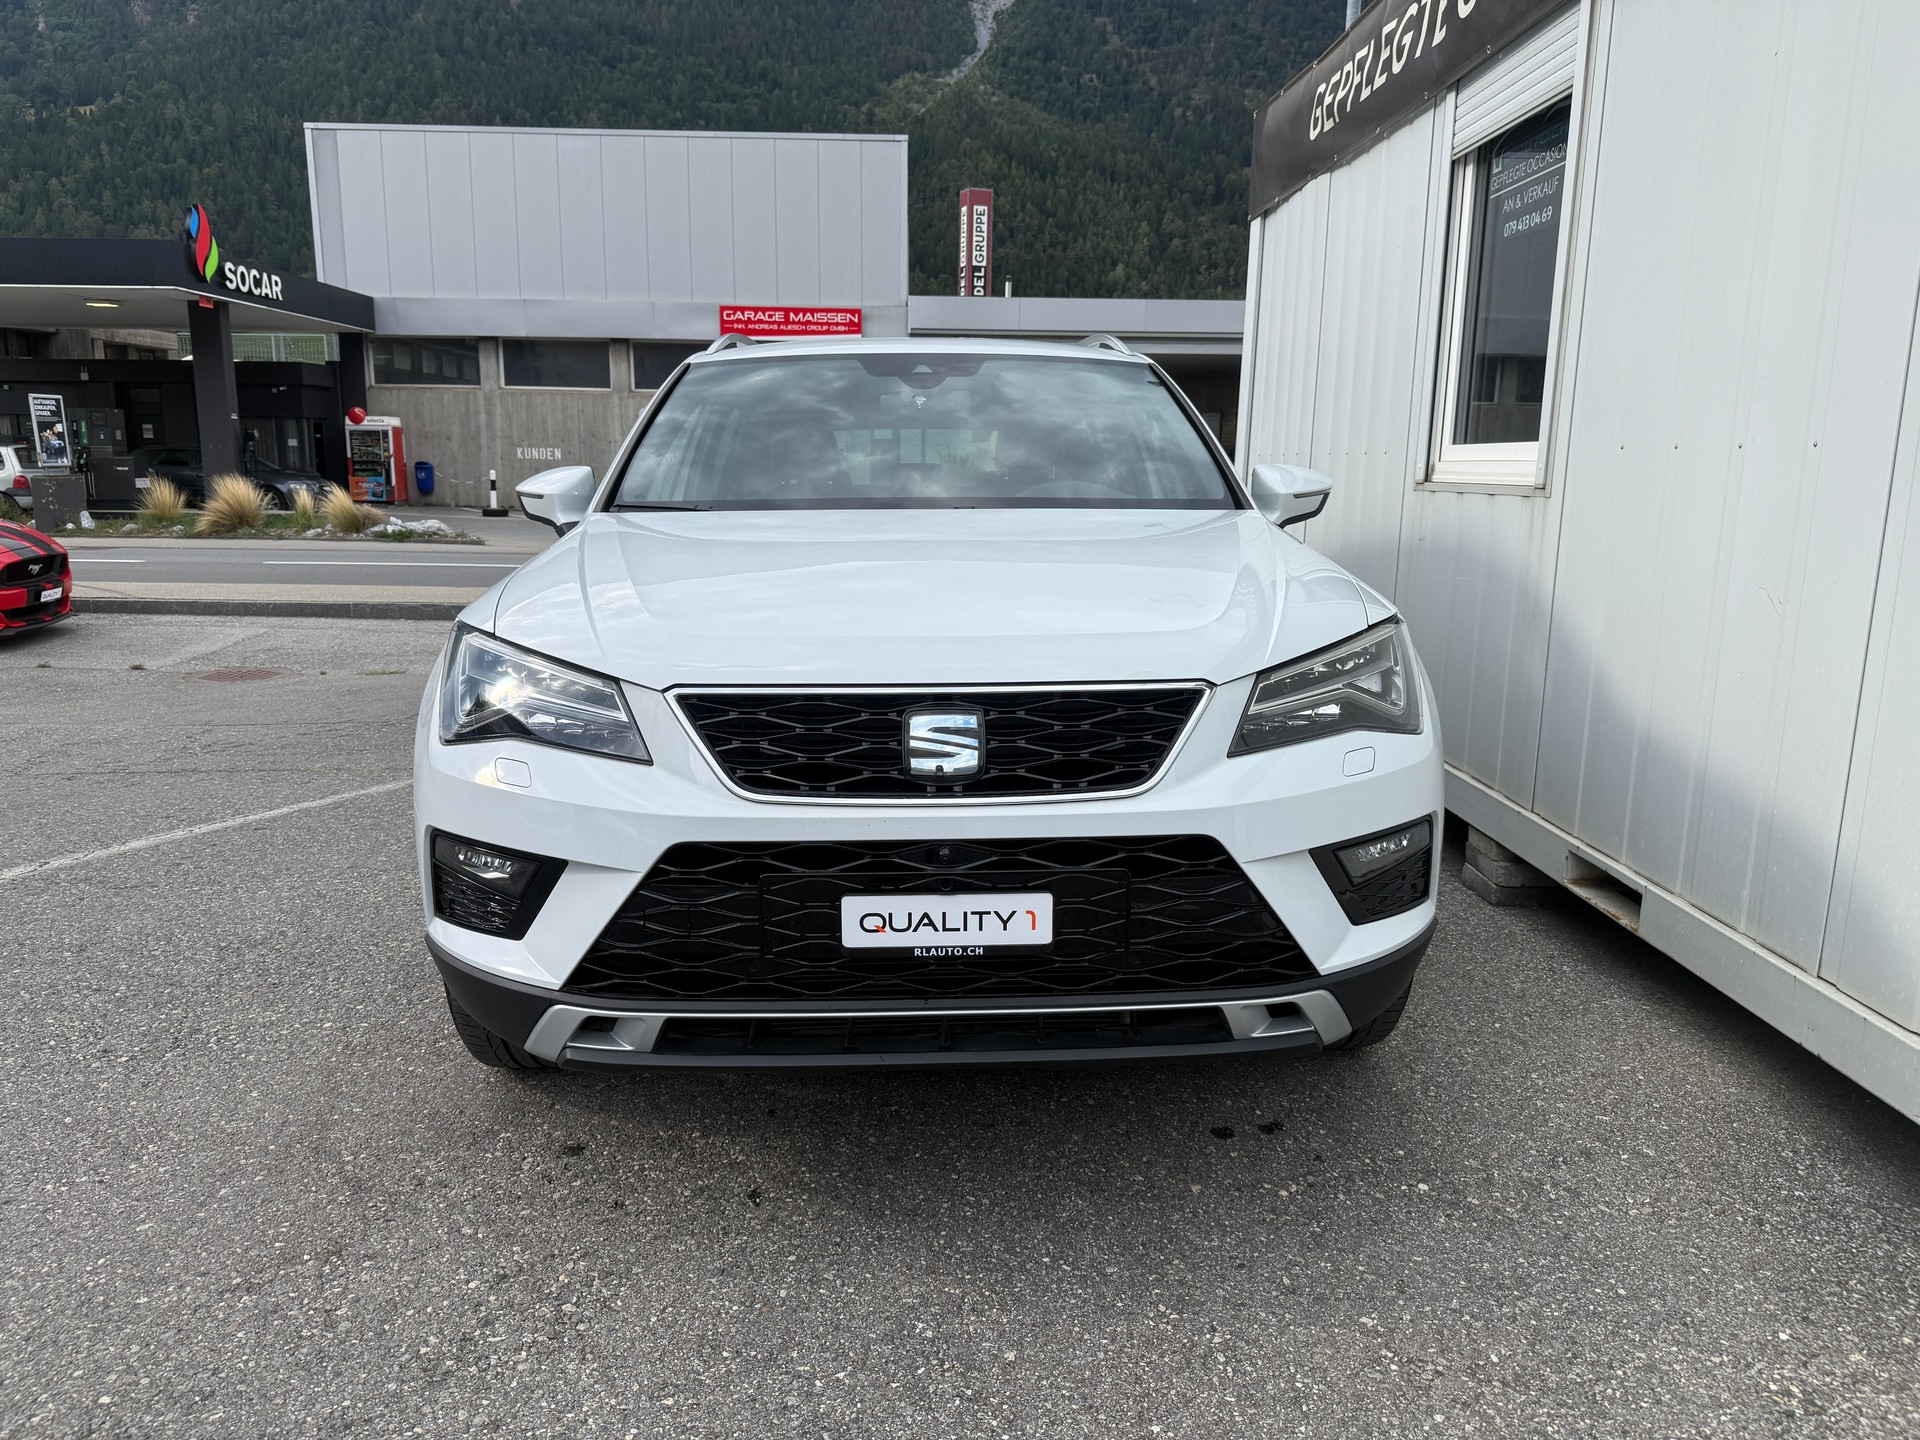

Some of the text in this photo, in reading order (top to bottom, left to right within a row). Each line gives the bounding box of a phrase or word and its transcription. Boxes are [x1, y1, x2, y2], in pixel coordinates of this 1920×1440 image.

[1309, 0, 1448, 141] GEPFLEGTE
[1490, 162, 1527, 191] GEPFLEGTE
[1502, 175, 1560, 215] AN & VERKAUF
[974, 208, 986, 264] GRUPPE
[1503, 205, 1553, 238] 079 413 04 69
[224, 261, 284, 301] SOCAR
[723, 310, 859, 324] GARAGE MAISSEN
[517, 447, 562, 460] KUNDEN
[858, 910, 1037, 934] QUALITY 1
[914, 946, 984, 957] RLAUTO.CH
